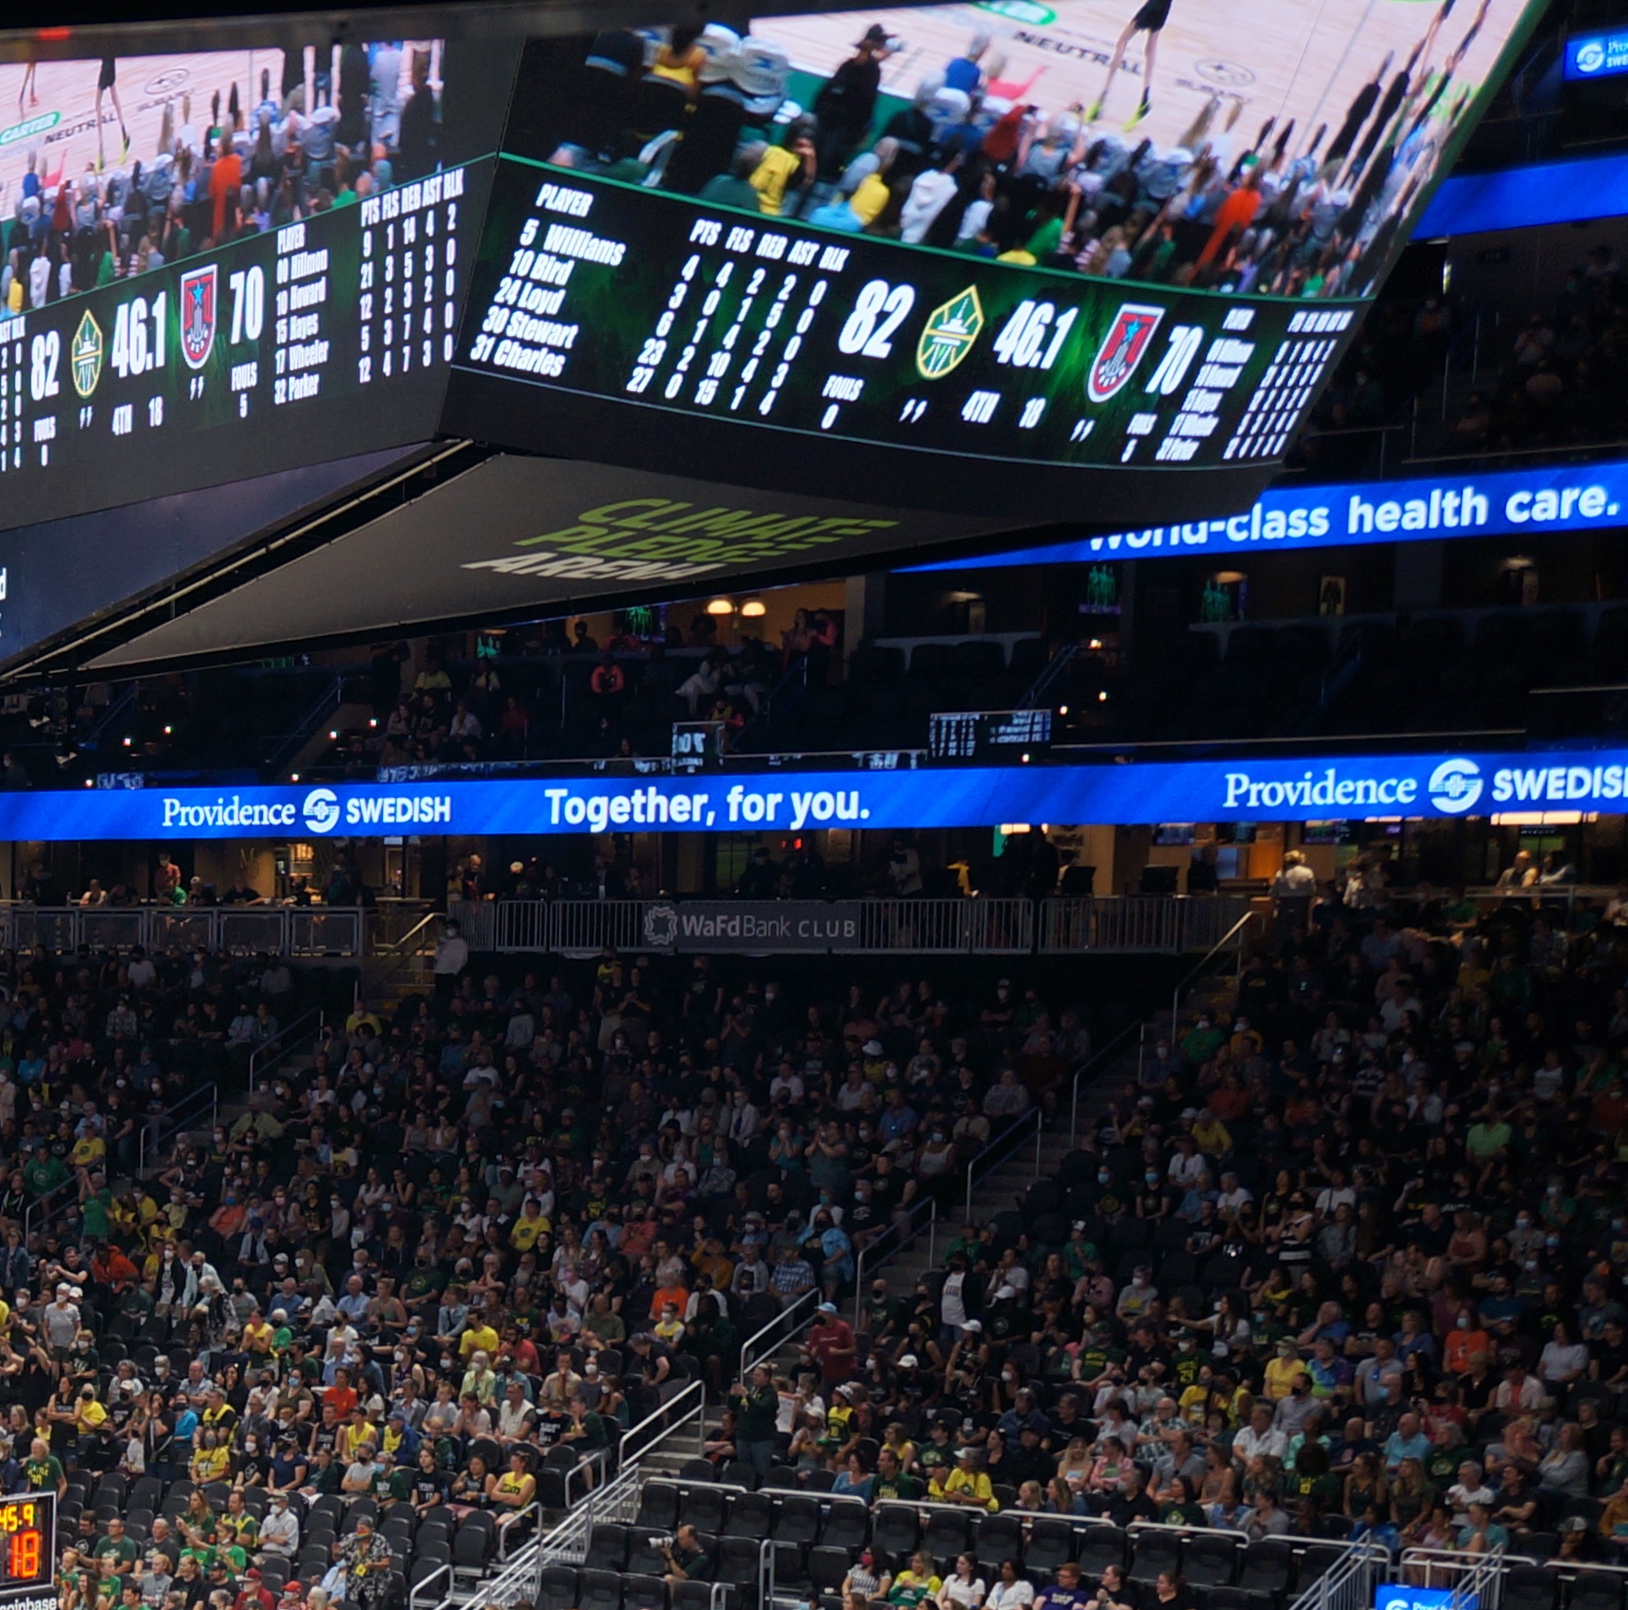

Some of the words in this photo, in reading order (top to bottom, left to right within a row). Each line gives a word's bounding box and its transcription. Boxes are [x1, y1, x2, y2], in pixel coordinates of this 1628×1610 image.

[536, 184, 593, 217] PLAYER
[690, 219, 722, 246] PTS
[726, 227, 754, 253] FLS
[756, 234, 788, 259] REB
[787, 240, 820, 265] AST
[819, 246, 849, 272] BLK
[520, 219, 539, 246] 5
[544, 224, 626, 266] Williams
[682, 255, 700, 281] 4
[716, 262, 734, 288] 4
[747, 269, 766, 294] 2
[778, 275, 796, 300] 2
[809, 281, 827, 306] 0
[230, 266, 264, 344] 70
[510, 249, 535, 277] 10
[530, 253, 574, 285] Bird
[669, 283, 687, 309] 3
[703, 290, 720, 316] 0
[737, 297, 752, 322] 1
[766, 302, 784, 328] 5
[797, 308, 814, 333] 0
[112, 292, 166, 377] 46.1
[494, 277, 522, 305] 24
[518, 282, 566, 315] Loyd
[656, 311, 674, 337] 6
[693, 319, 708, 343] 1
[723, 325, 740, 349] 4
[753, 330, 771, 355] 2
[784, 336, 801, 361] 0
[839, 280, 914, 358] 82
[993, 301, 1078, 369] 46.1
[31, 331, 59, 400] 82
[483, 306, 510, 334] 30
[506, 311, 578, 349] Stewart
[638, 338, 666, 365] 23
[677, 346, 695, 371] 2
[707, 352, 731, 377] 10
[742, 358, 759, 383] 4
[771, 363, 789, 388] 3
[1146, 326, 1203, 394] 70
[232, 362, 257, 391] FOULS
[470, 334, 496, 361] 31
[494, 340, 565, 377] Charles
[627, 366, 654, 393] 27
[665, 373, 683, 399] 0
[695, 379, 719, 405] 15
[731, 386, 746, 410] 1
[759, 390, 776, 415] 4
[822, 375, 863, 401] FOULS
[112, 404, 132, 435] 4TH
[149, 397, 163, 426] 18
[240, 394, 247, 417] 5
[822, 404, 839, 429] 0
[962, 391, 1000, 423] 4TH
[1019, 398, 1046, 428] 18
[578, 498, 901, 543] CLIMATE
[1349, 487, 1488, 533] health
[1506, 486, 1618, 523] care.
[460, 551, 727, 580] ARENA
[513, 525, 816, 564] PLEDGE
[163, 796, 295, 826] Providence
[347, 797, 450, 823] SWEDISH
[545, 787, 715, 833] Together,
[727, 785, 783, 821] for
[790, 791, 869, 835] you.
[1223, 769, 1417, 807] Providence
[1492, 766, 1628, 801] SWEDIS
[797, 919, 856, 938] CLUB
[10, 1530, 40, 1579] 18
